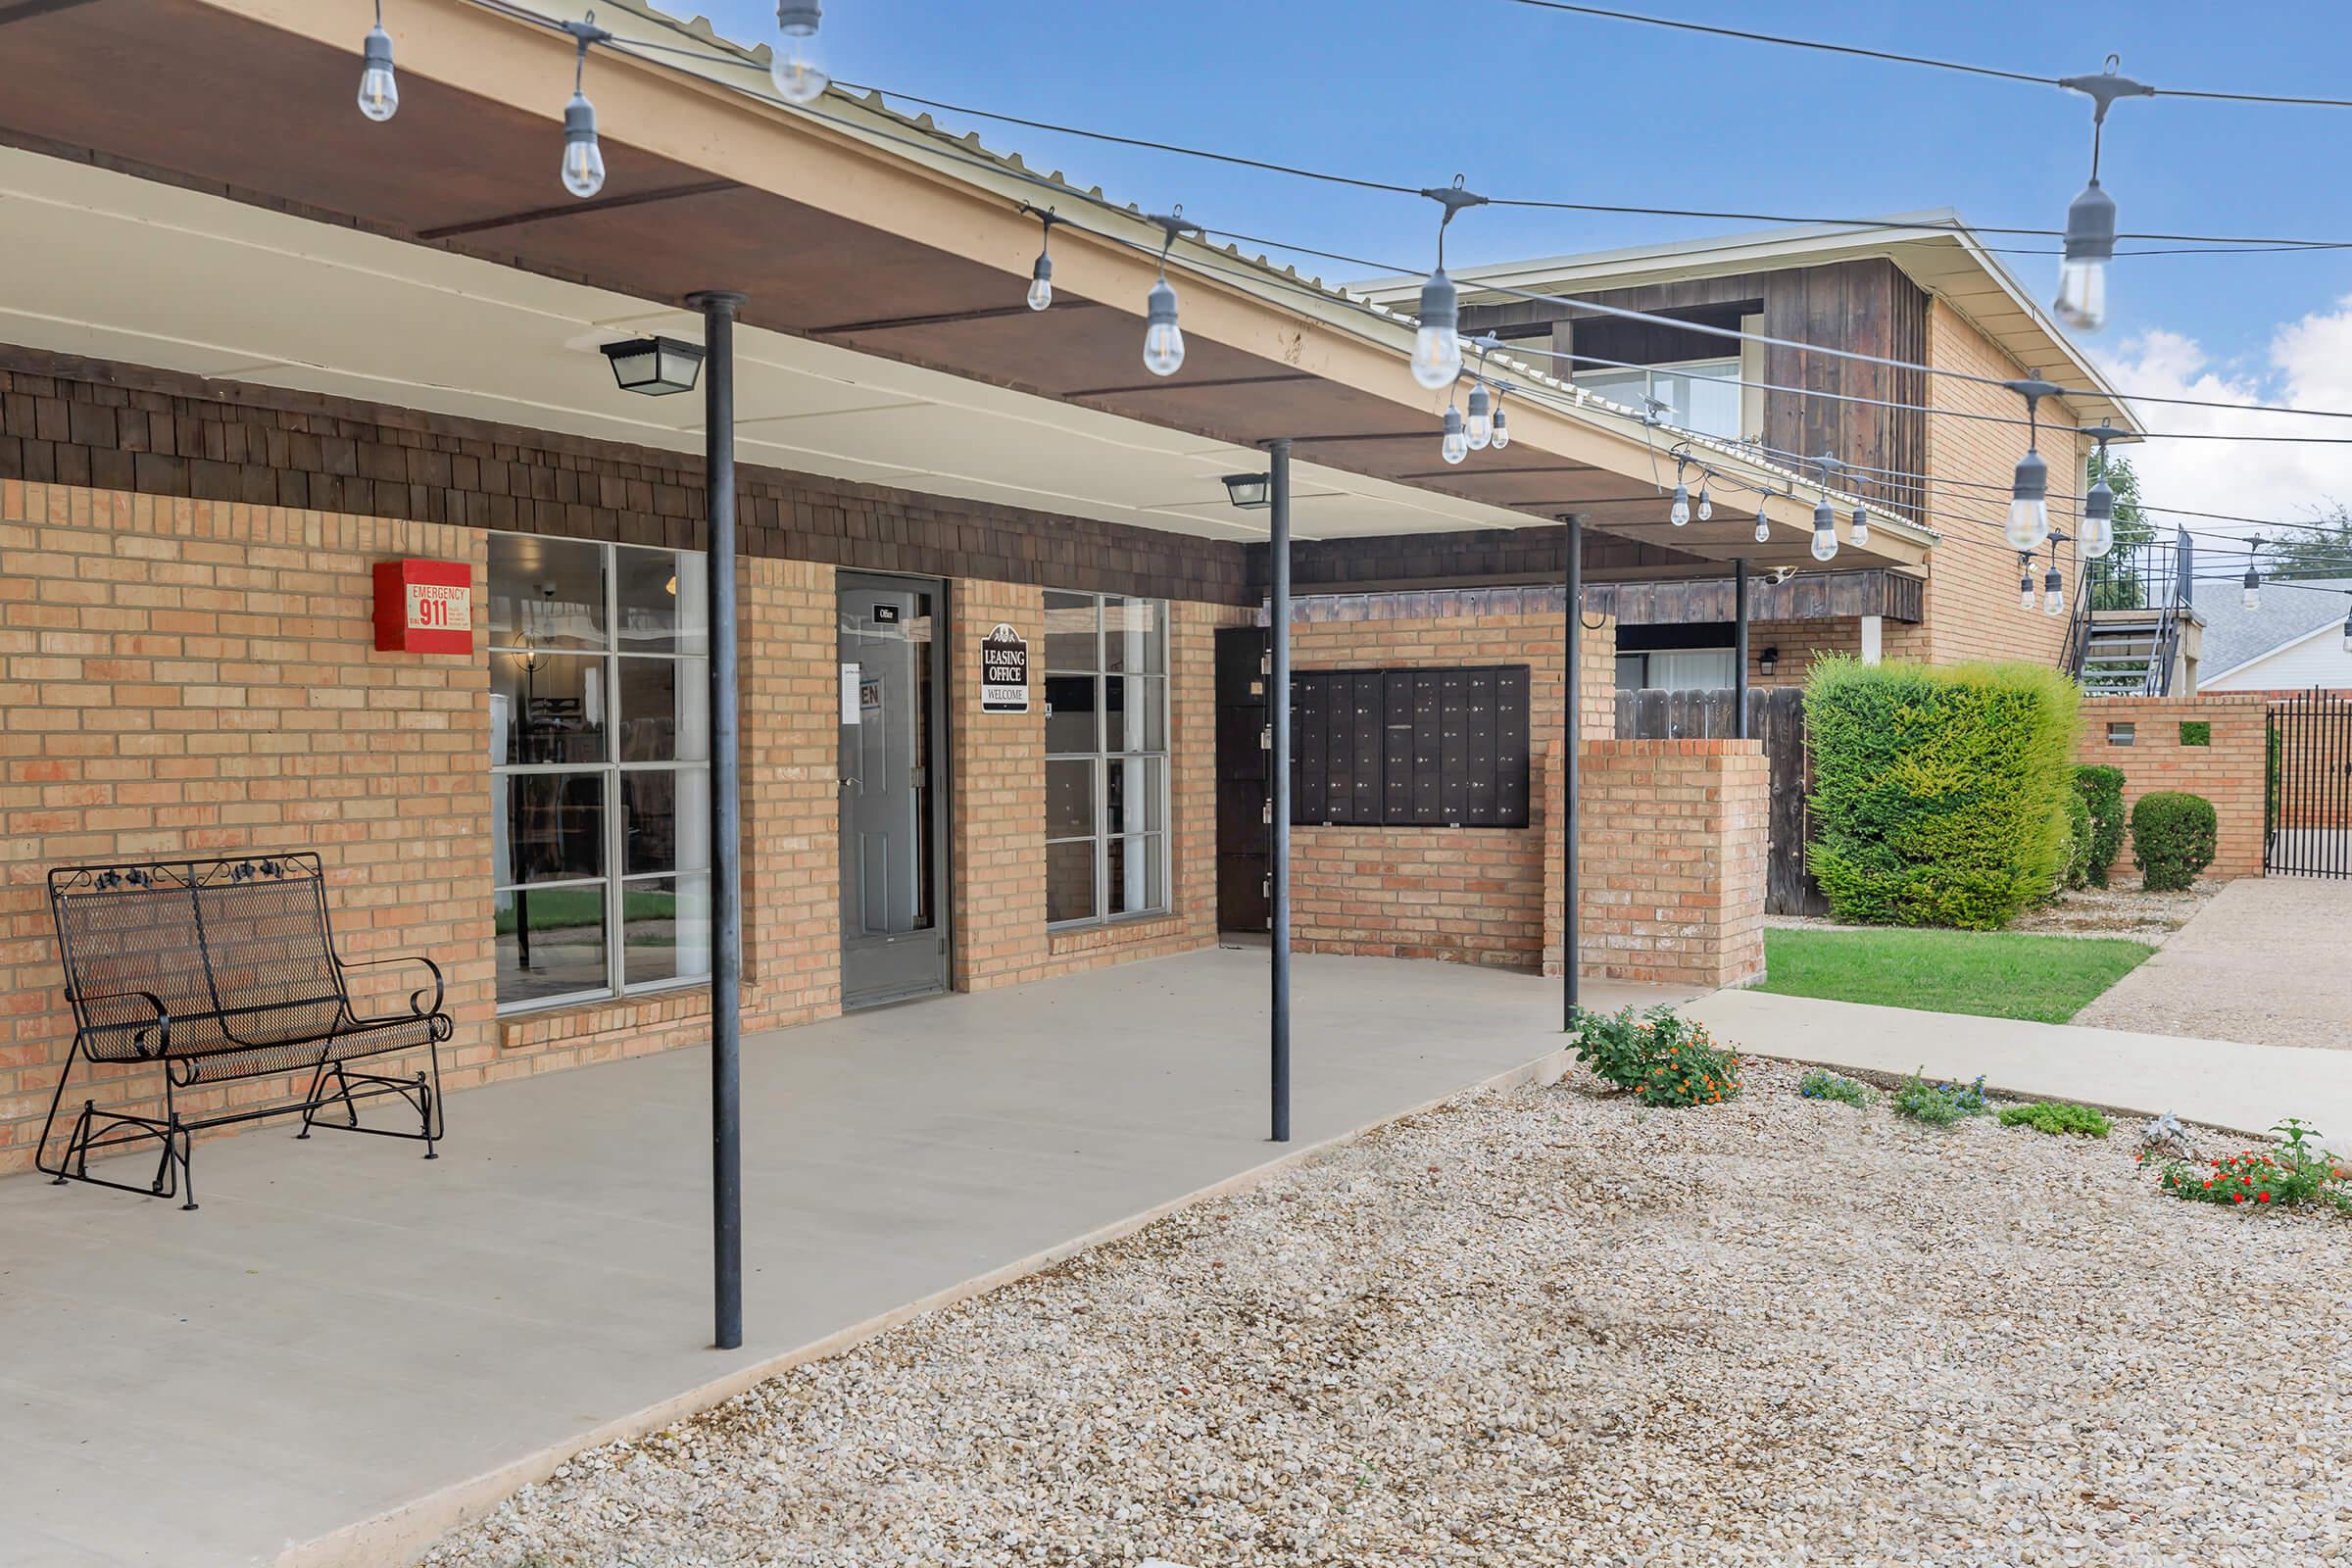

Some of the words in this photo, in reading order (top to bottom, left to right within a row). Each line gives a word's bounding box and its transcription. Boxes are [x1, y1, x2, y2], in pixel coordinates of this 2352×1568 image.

[413, 586, 465, 600] EMERGENCY
[419, 598, 448, 627] 911
[985, 650, 1025, 665] LEASING
[989, 666, 1021, 682] OFFICE
[861, 685, 879, 705] EN
[988, 689, 1022, 700] WELCOME
